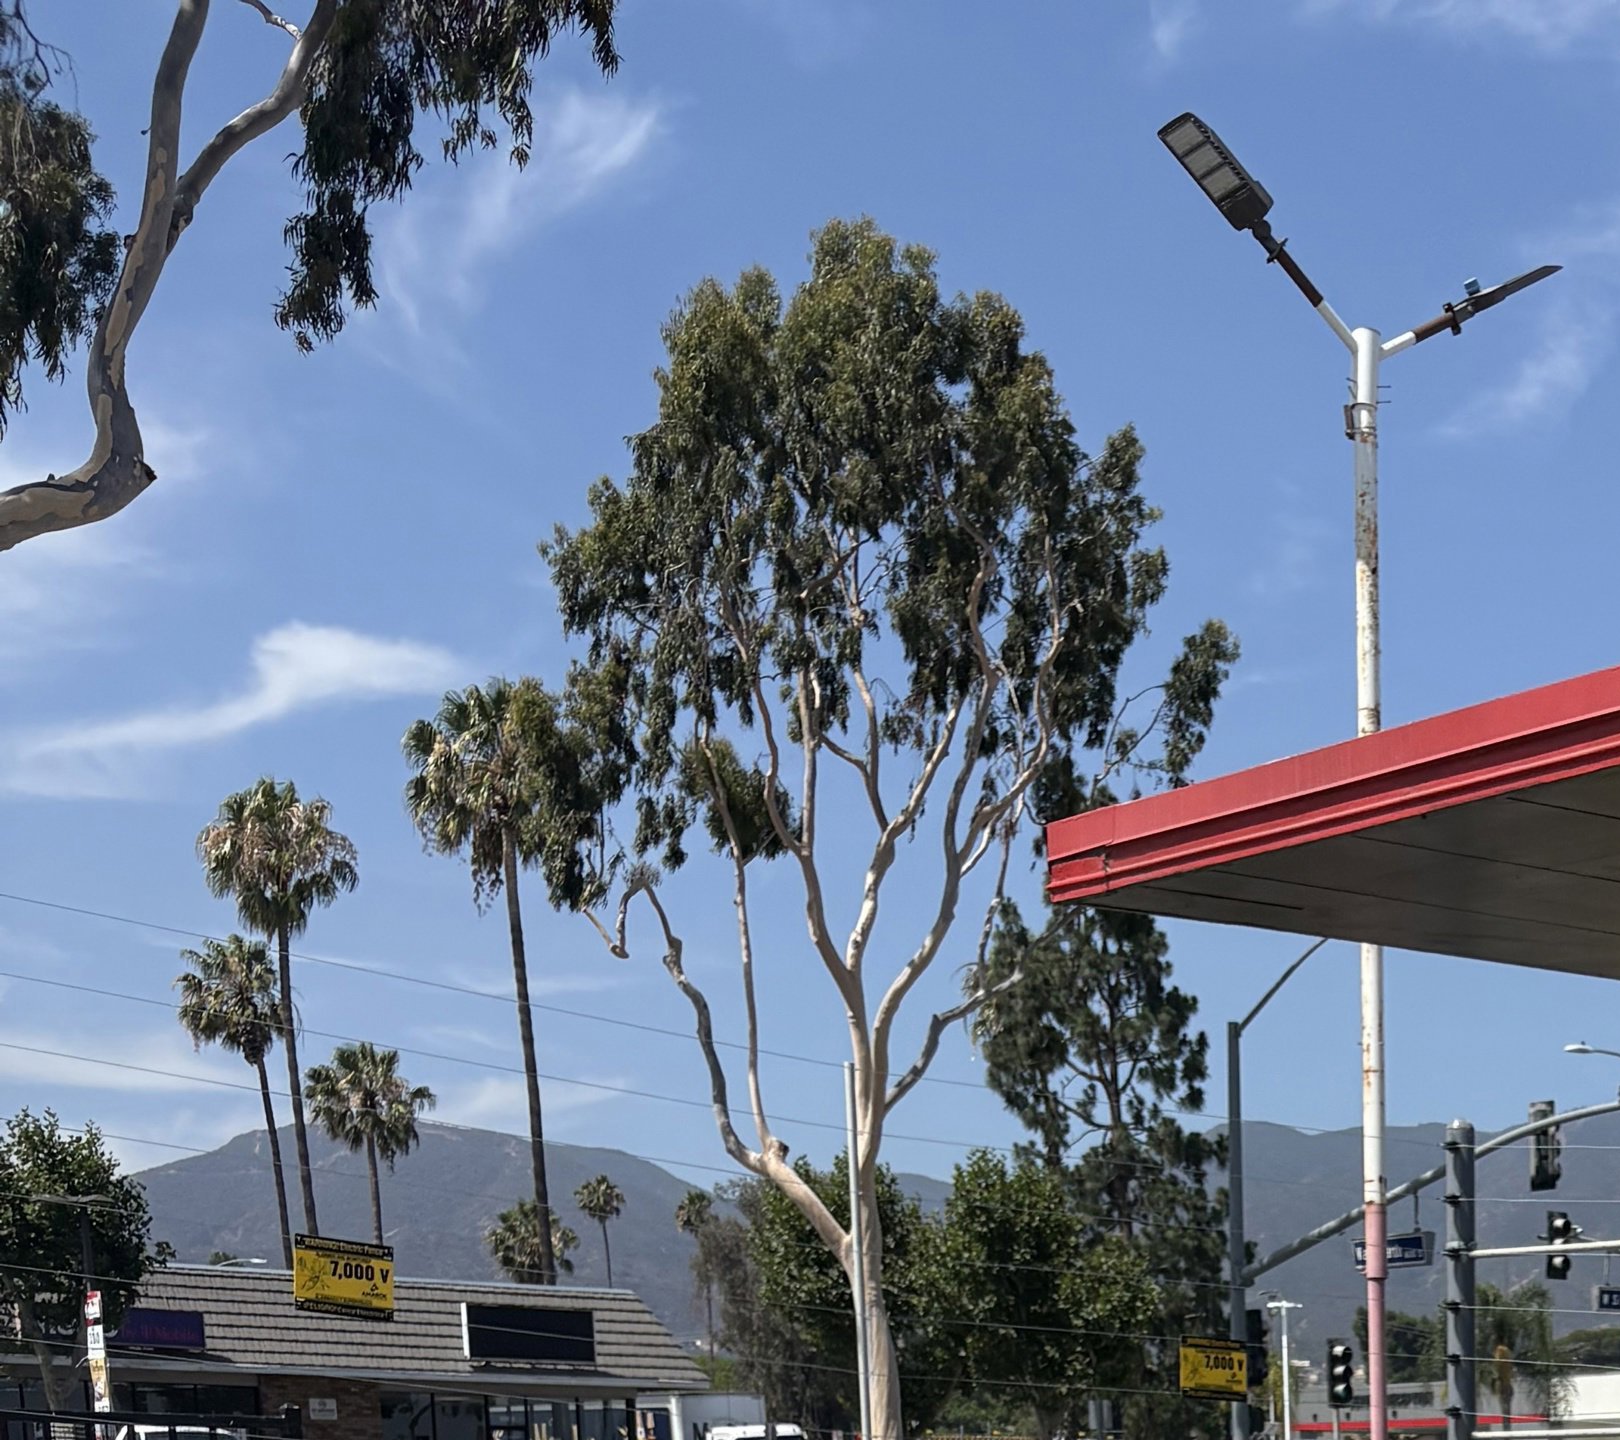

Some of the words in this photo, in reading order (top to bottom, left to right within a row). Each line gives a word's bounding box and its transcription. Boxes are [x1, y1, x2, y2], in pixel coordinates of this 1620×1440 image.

[330, 1260, 374, 1281] 7,000
[380, 1268, 389, 1284] V
[1204, 1355, 1234, 1370] 7,000
